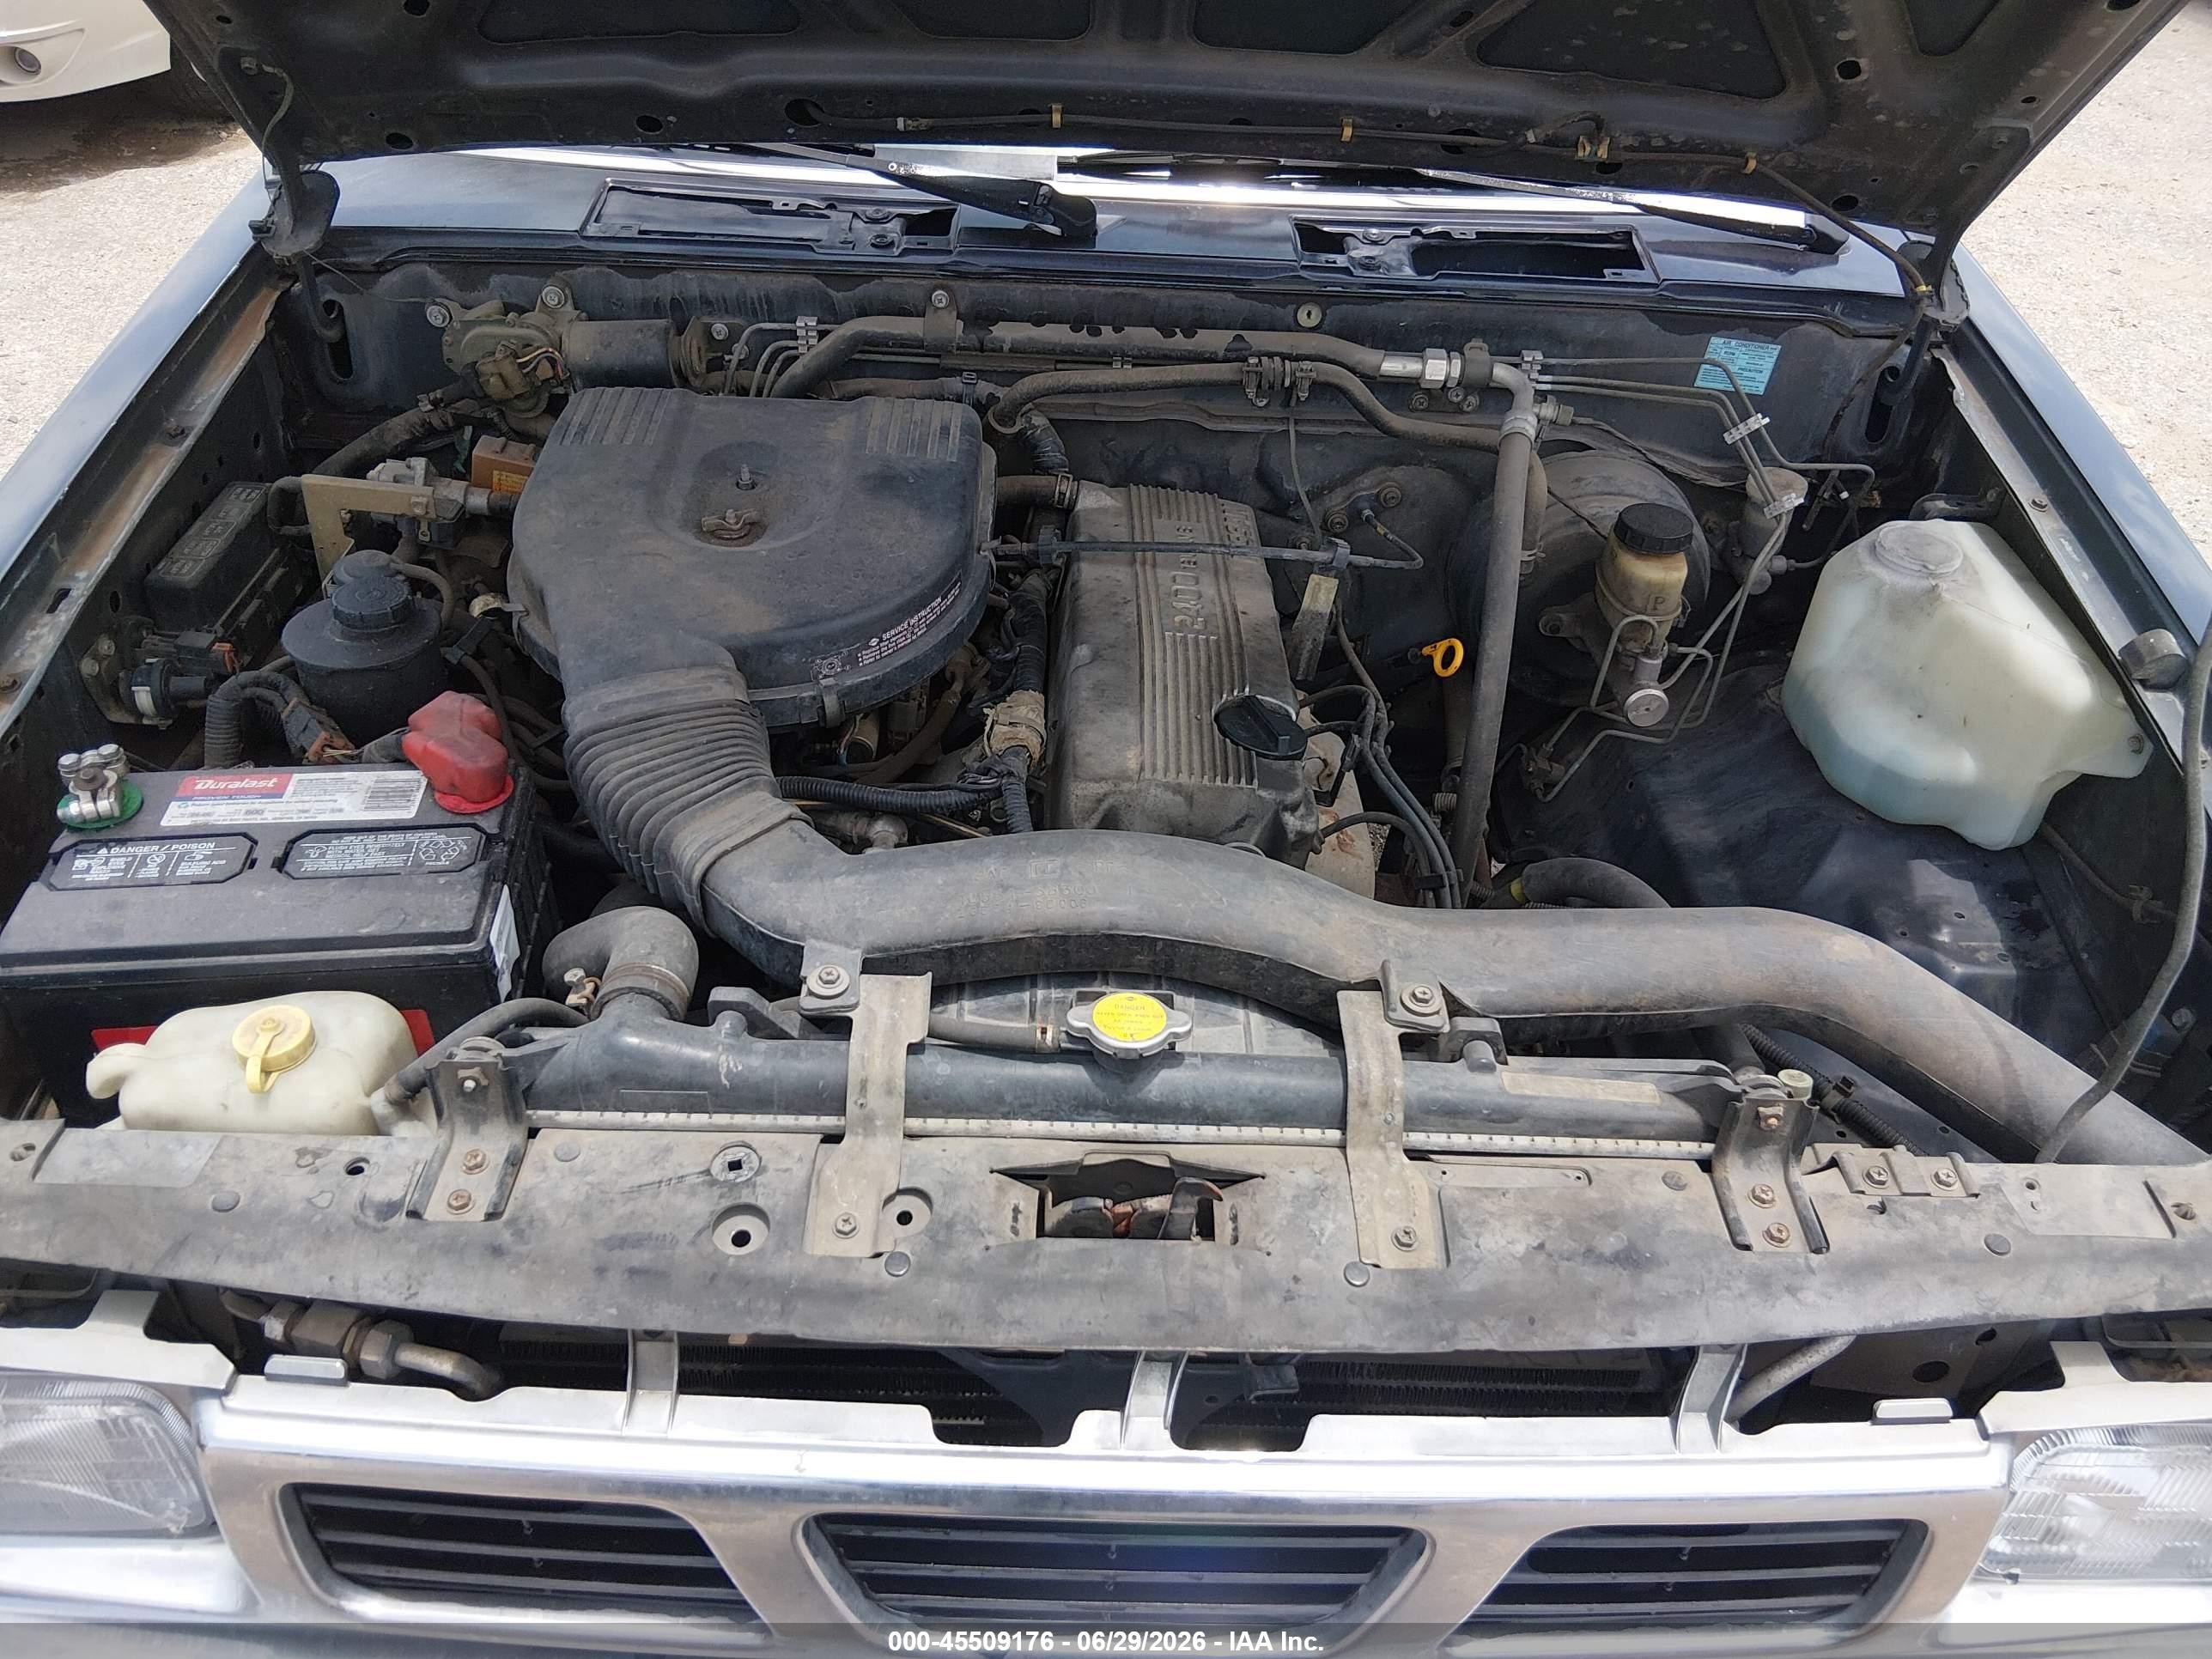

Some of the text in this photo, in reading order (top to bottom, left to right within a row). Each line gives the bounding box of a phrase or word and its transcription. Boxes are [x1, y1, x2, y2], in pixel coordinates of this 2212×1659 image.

[882, 620, 908, 641] SERVICE
[910, 596, 942, 625] INSTRUCTION
[193, 778, 278, 790] Duralast
